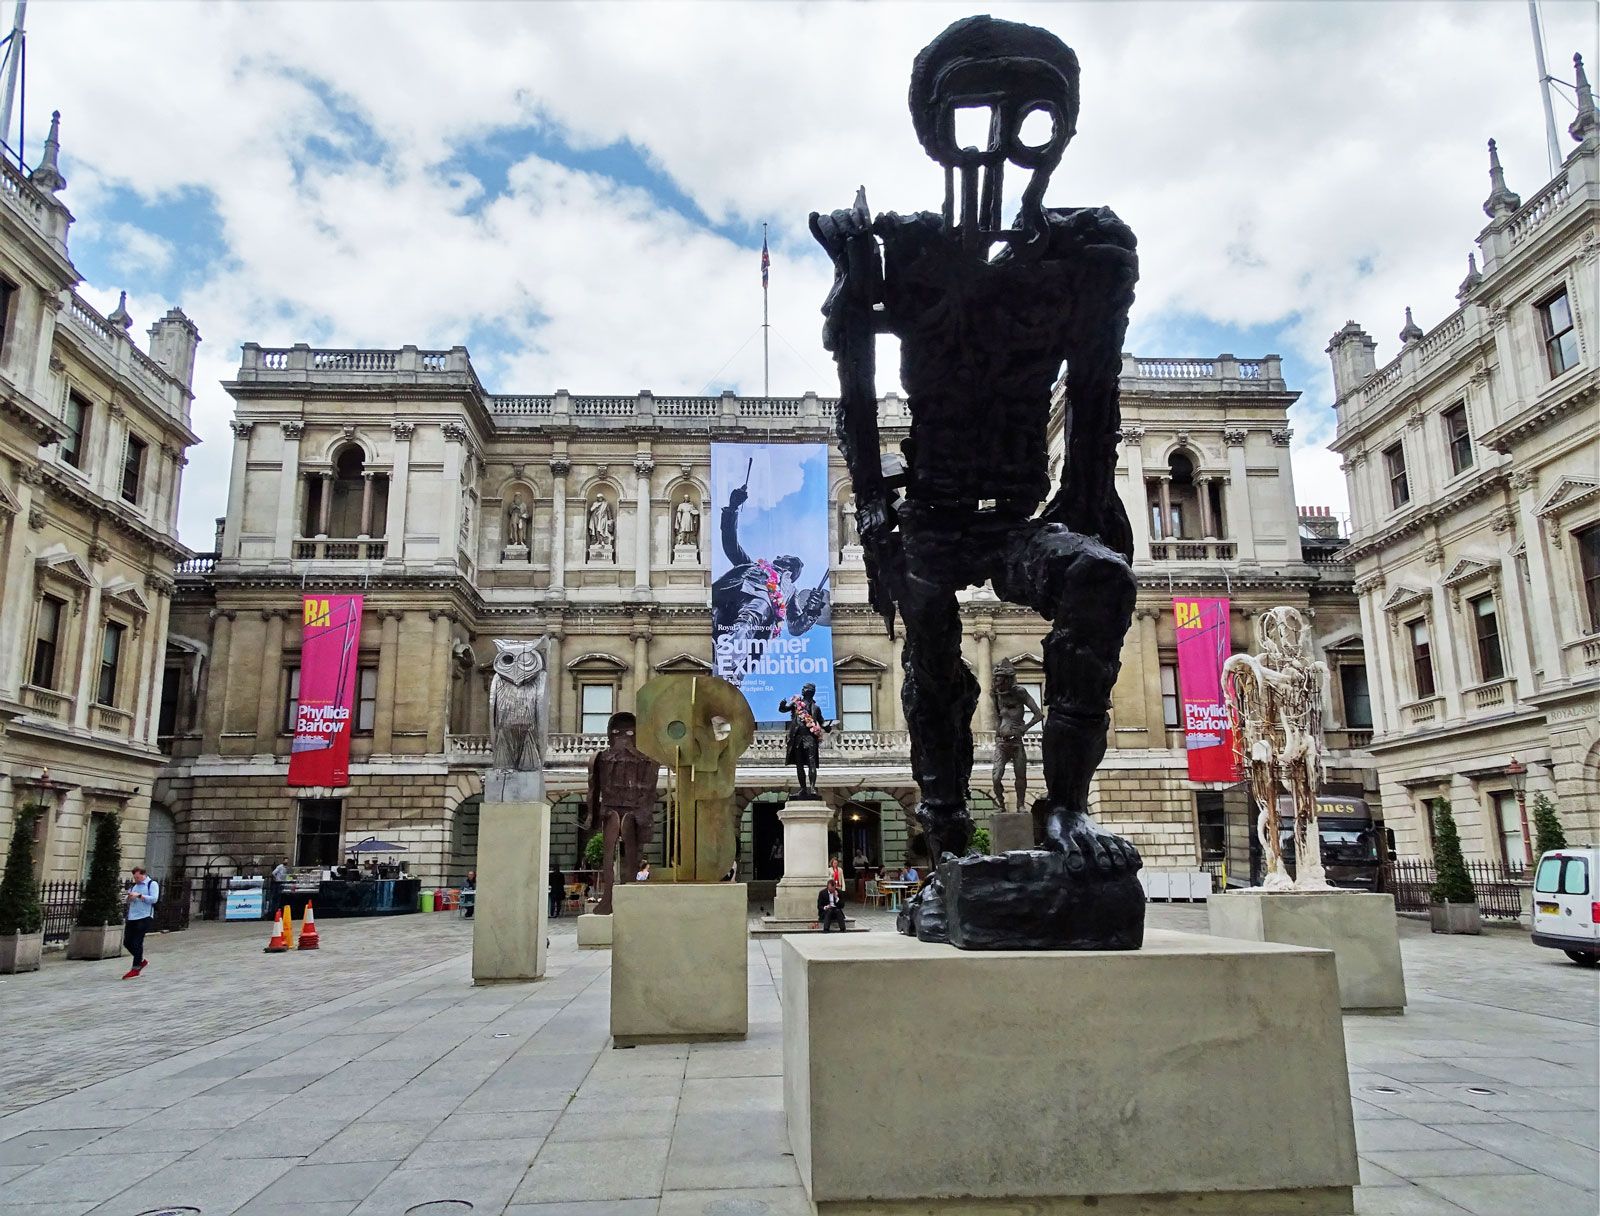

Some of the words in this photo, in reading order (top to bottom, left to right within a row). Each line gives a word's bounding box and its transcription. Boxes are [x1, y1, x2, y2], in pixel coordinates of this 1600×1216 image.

[304, 599, 331, 627] RA
[1175, 602, 1202, 629] RA
[717, 623, 737, 632] Royal
[716, 633, 810, 655] Summer
[717, 654, 828, 675] Exhibition
[298, 705, 350, 721] Phyllida
[1184, 703, 1231, 720] Phyllid
[1550, 707, 1580, 721] ROYAL
[297, 718, 344, 732] Barlow
[1186, 716, 1233, 730] Barlow
